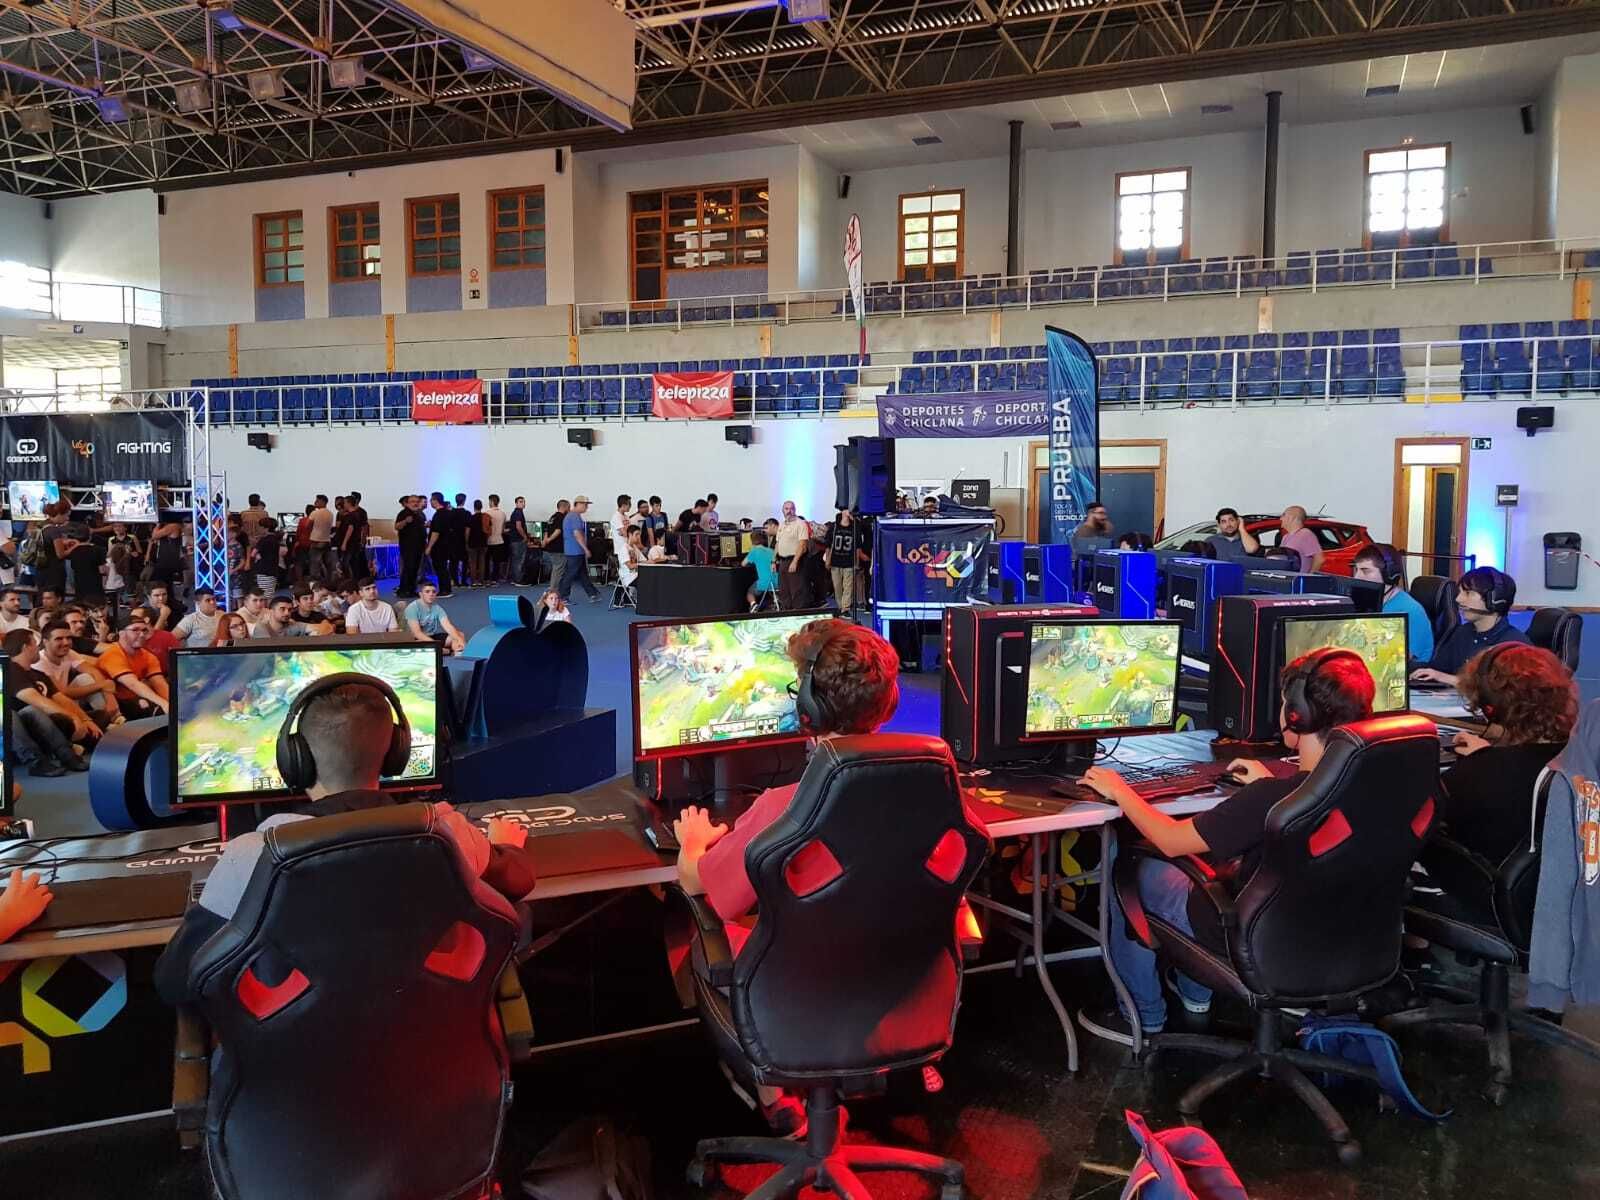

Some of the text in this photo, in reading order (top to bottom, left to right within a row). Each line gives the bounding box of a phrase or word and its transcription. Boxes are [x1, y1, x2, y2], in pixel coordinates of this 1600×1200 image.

[416, 391, 479, 410] telepizza
[657, 384, 729, 405] telepizza
[902, 405, 965, 416] DEPORTES
[995, 402, 1047, 413] DEPORT
[903, 417, 965, 428] CHICLANA
[995, 414, 1049, 426] CHICLAN
[116, 441, 171, 454] FIGHTING
[1052, 397, 1072, 501] PRUEBA
[834, 535, 853, 551] 03
[126, 854, 222, 868] GAMIN
